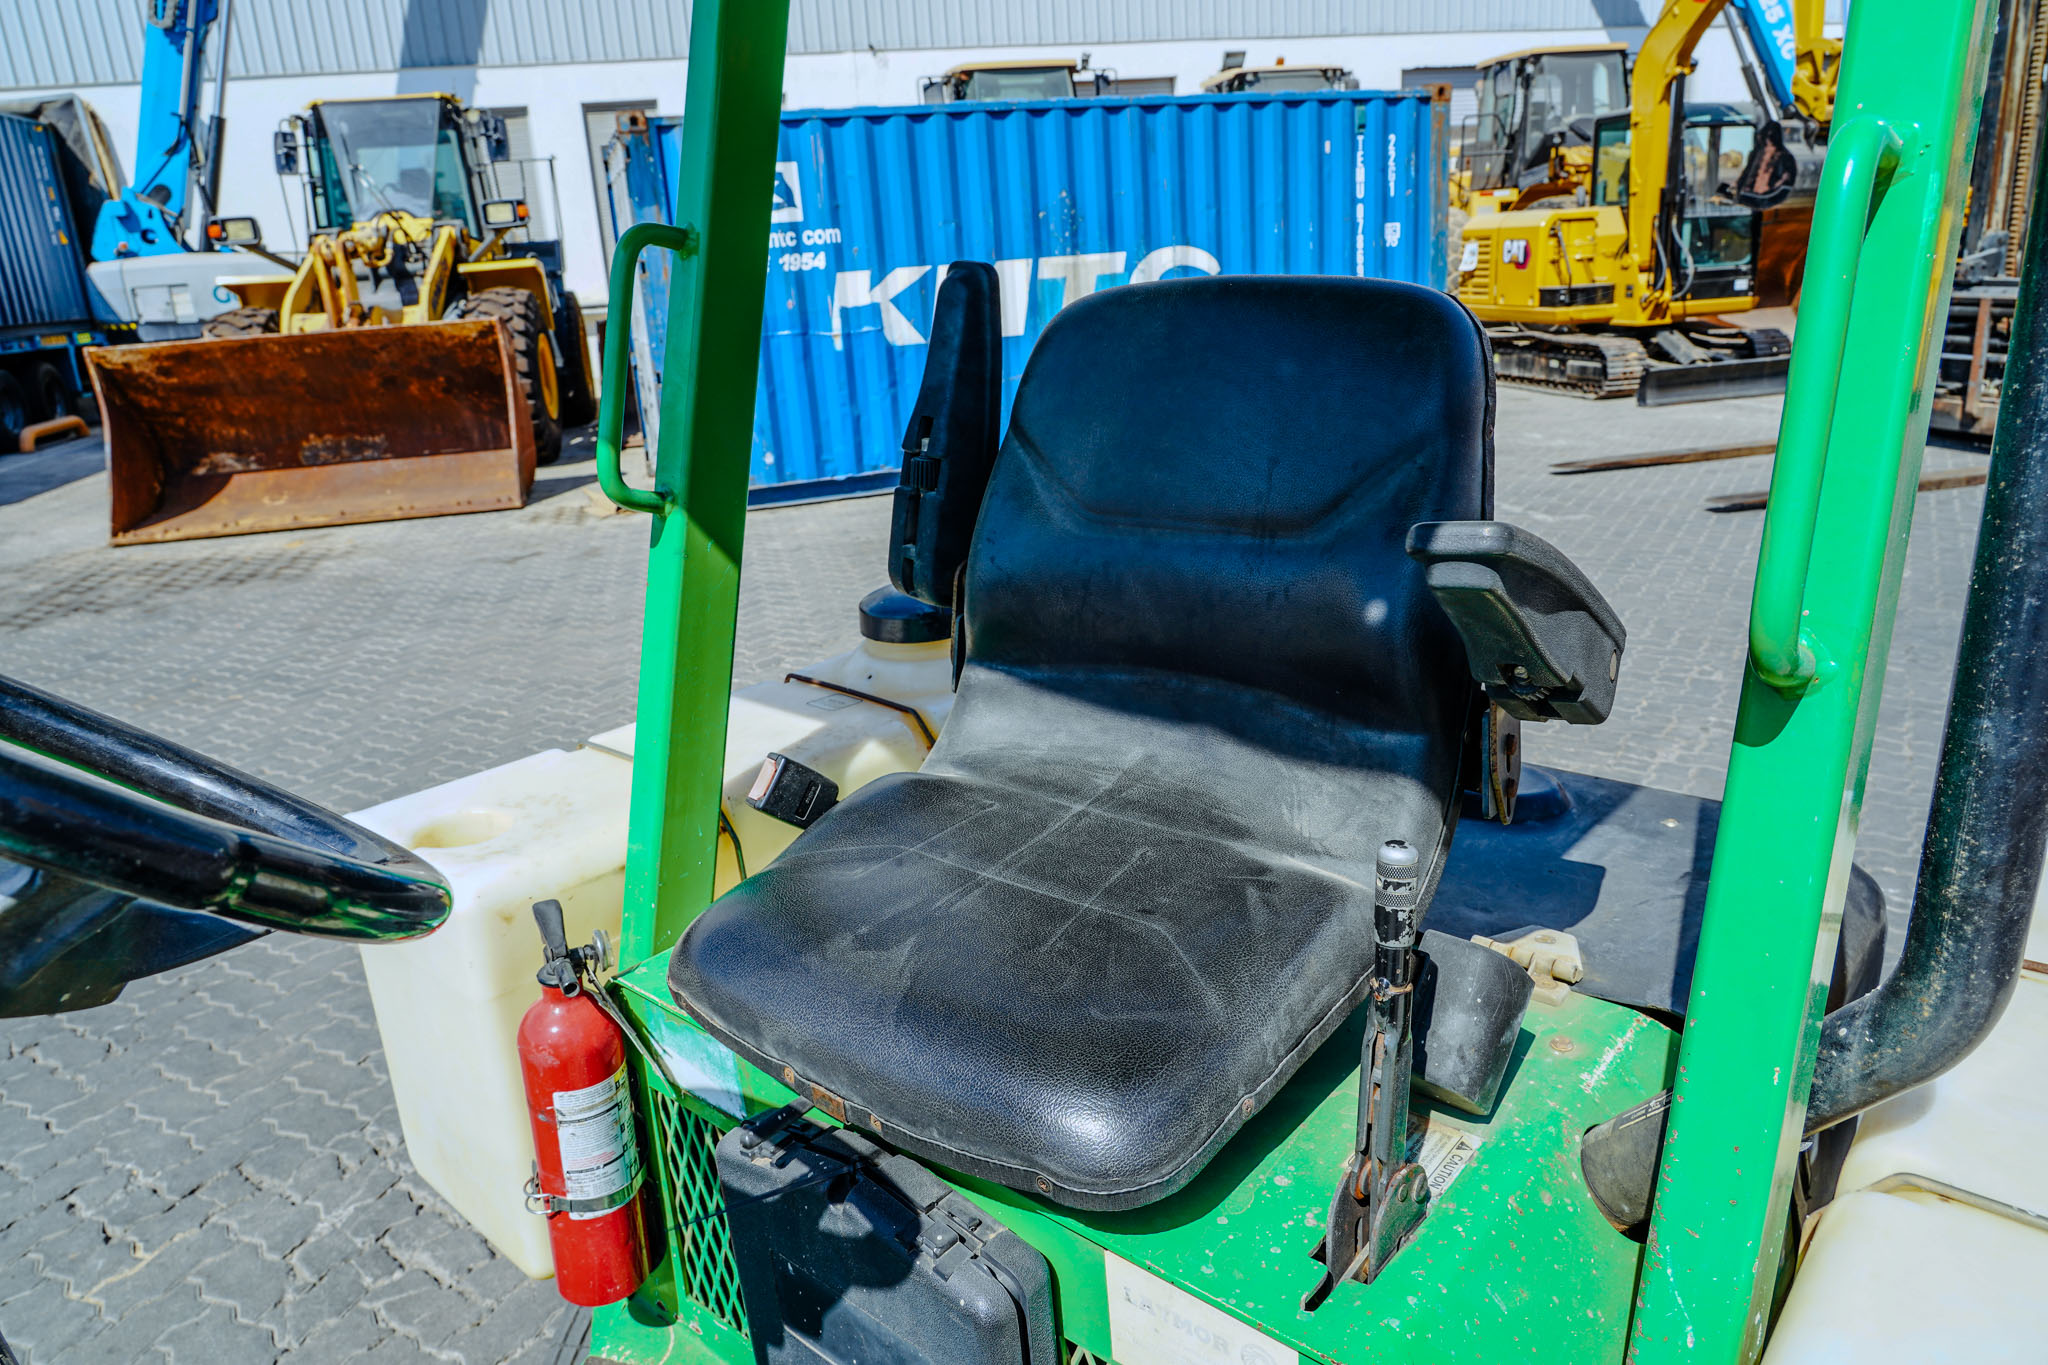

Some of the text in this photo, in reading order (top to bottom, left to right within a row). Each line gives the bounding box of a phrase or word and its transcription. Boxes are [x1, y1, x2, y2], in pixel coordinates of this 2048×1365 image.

[802, 227, 842, 246] com
[778, 250, 827, 272] 1954
[1503, 239, 1527, 264] CAT
[832, 245, 1222, 351] KT
[1428, 1153, 1464, 1190] CAUTION
